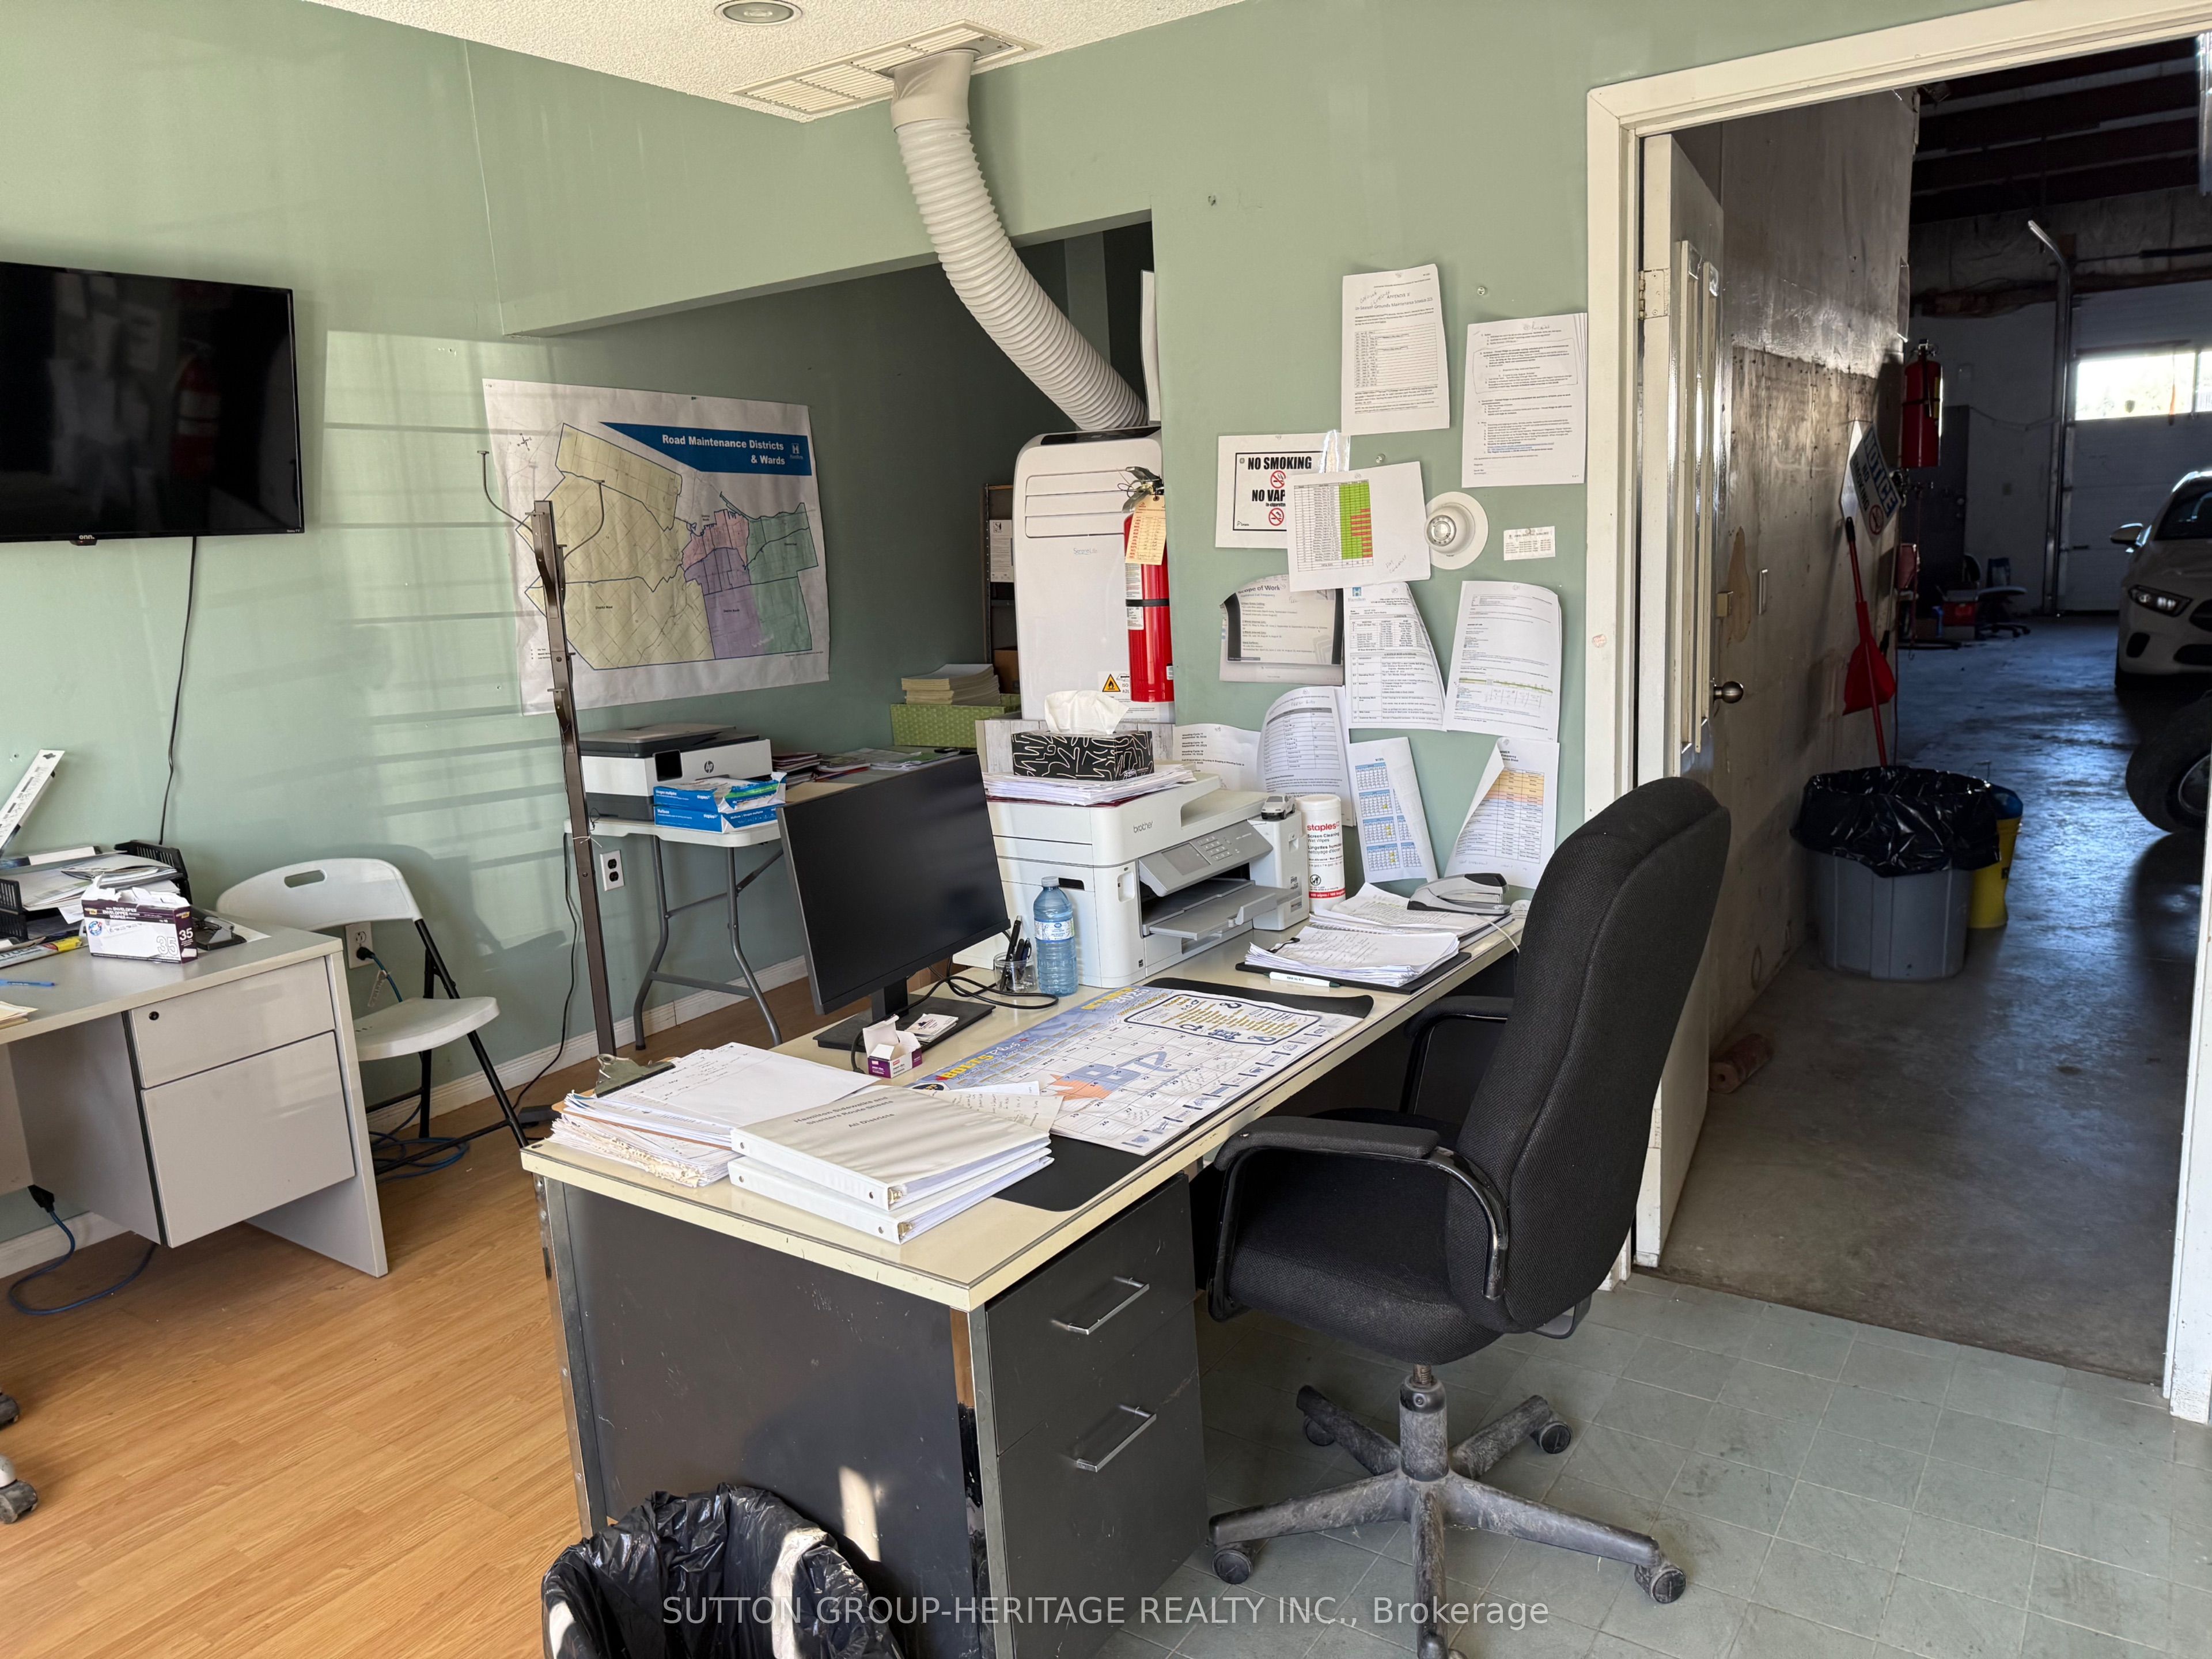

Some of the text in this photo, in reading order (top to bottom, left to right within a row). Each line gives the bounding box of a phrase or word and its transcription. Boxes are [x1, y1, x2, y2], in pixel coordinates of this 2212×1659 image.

[662, 434, 785, 451] Road Maintenance Districts
[751, 454, 786, 465] & Wards
[1248, 456, 1312, 470] NO SMOKING
[1863, 426, 1899, 518] NOTICE
[1252, 489, 1265, 502] NO
[704, 760, 715, 774] hp
[1133, 820, 1155, 834] brother
[1306, 823, 1336, 832] staples
[179, 927, 194, 941] 35
[156, 935, 179, 956] 35
[1109, 988, 1150, 1003] 2025
[986, 1041, 1021, 1055] Plus
[941, 1054, 994, 1079] BOLTS
[793, 1110, 833, 1123] Hamilton
[832, 1100, 874, 1112] Sidewalks
[806, 1100, 893, 1125] Shelters Route Sheets
[860, 1113, 895, 1124] Districts
